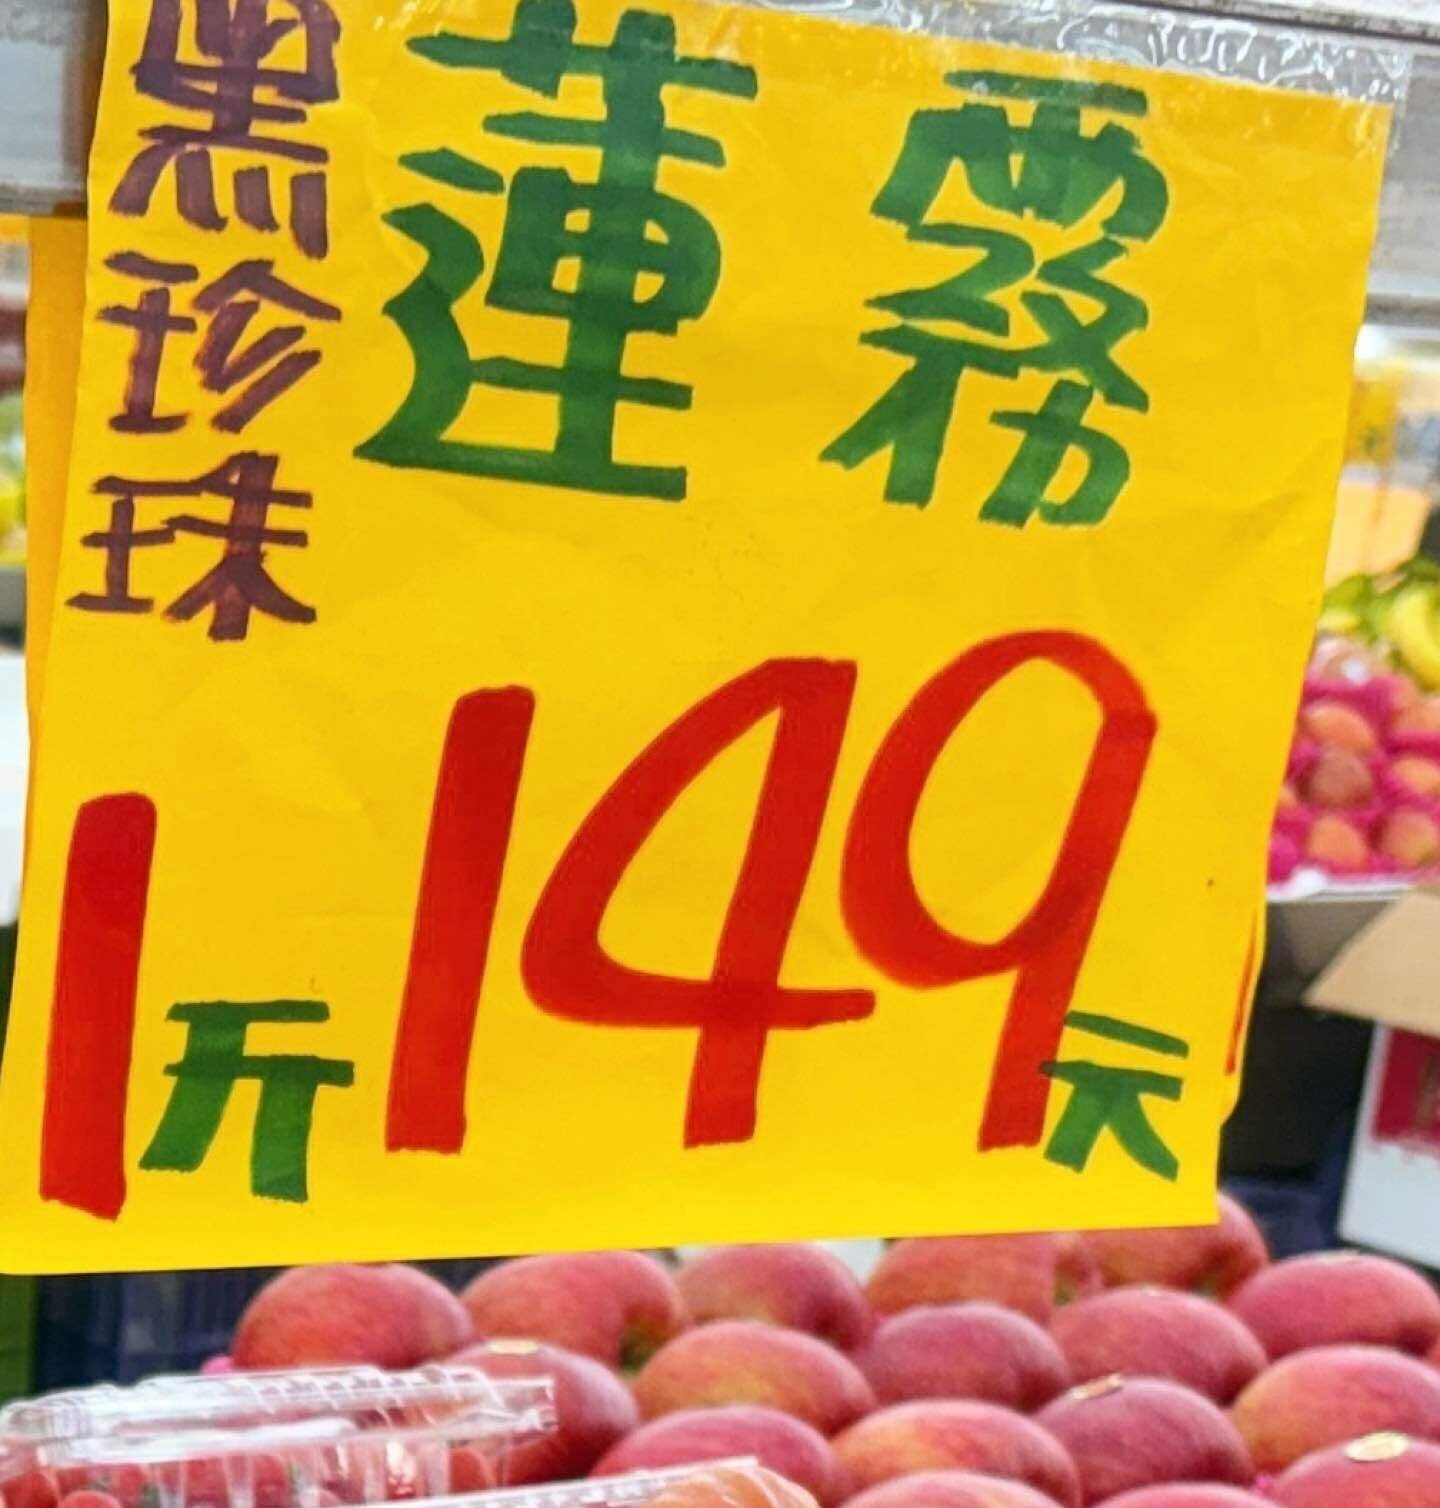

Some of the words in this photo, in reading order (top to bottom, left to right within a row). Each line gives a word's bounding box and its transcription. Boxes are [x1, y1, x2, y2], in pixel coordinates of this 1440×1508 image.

[67, 0, 340, 641] 黑珍珠
[356, 0, 1170, 526] 蓮霧
